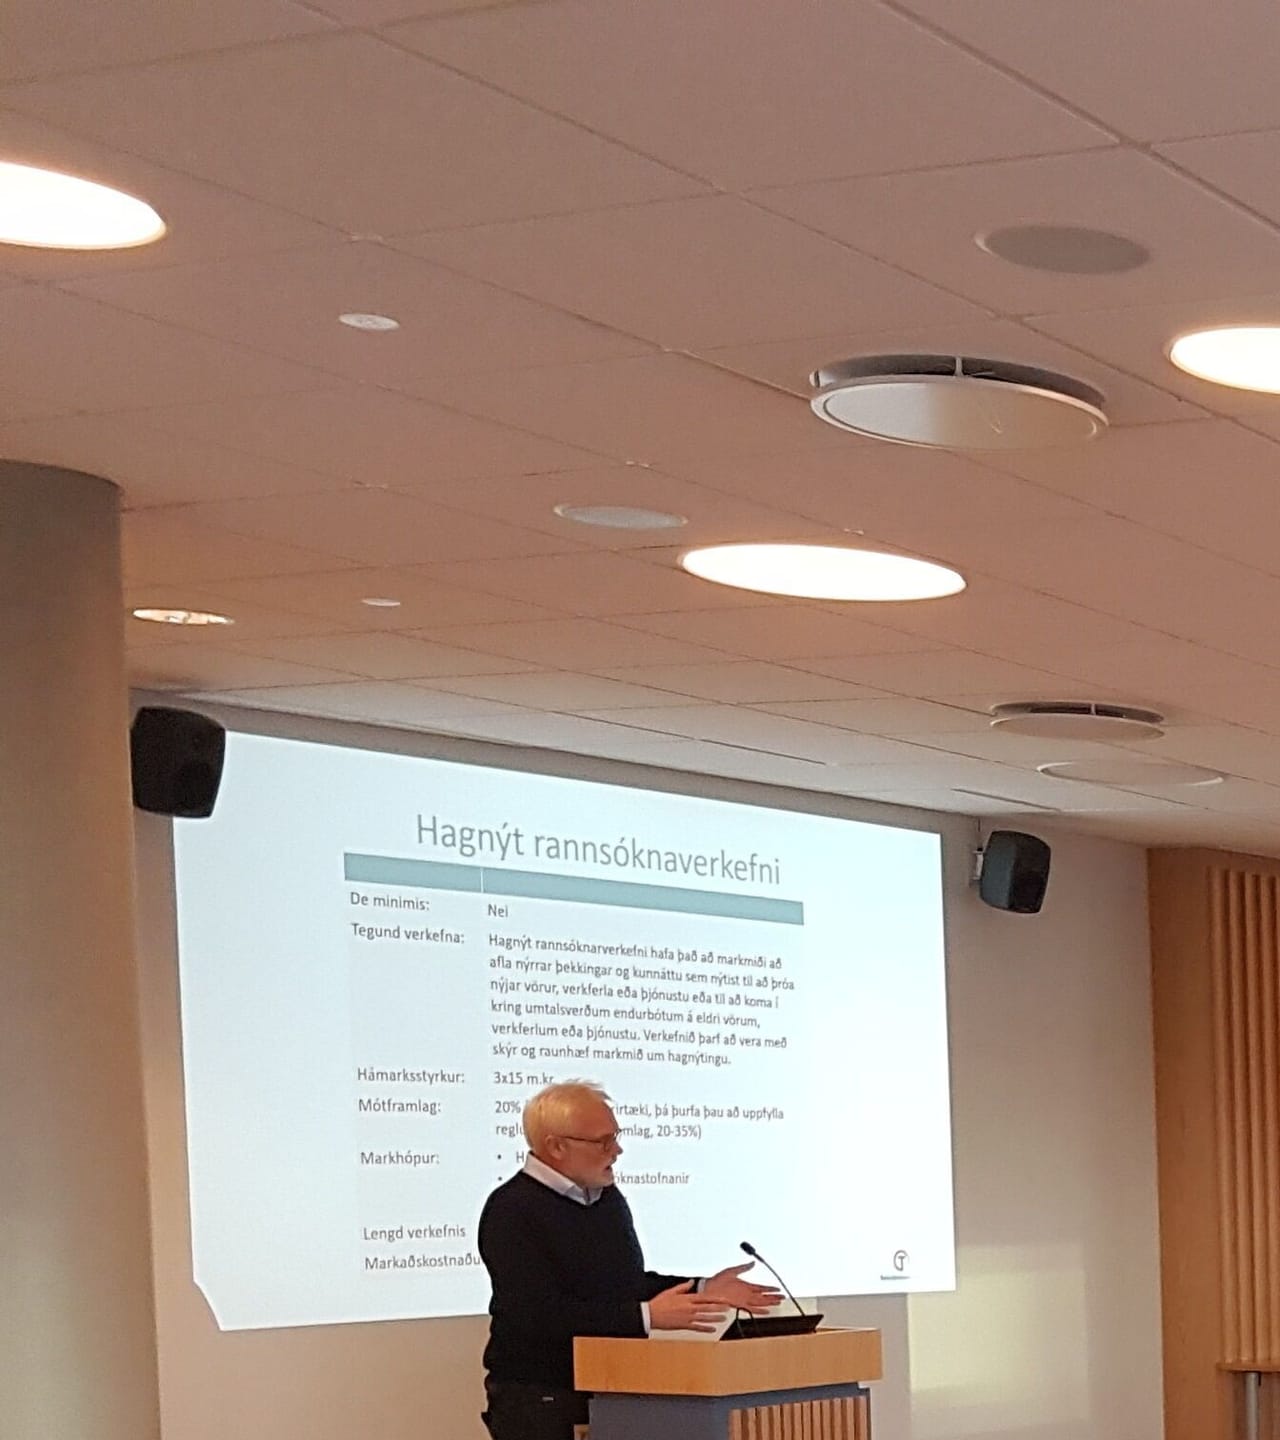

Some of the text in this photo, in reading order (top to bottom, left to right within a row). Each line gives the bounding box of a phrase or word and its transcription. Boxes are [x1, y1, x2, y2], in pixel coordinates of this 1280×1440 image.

[416, 813, 780, 884] Hagnýt rannsóknaverkefni
[349, 890, 430, 910] De minimis:
[486, 902, 509, 917] Nei
[350, 921, 465, 943] Tegund verkefna:
[487, 932, 782, 969] Hagnýt rannsóknarverkefni hafa það að markmiði að
[488, 953, 795, 991] afla nýrrar þekkingar og kunnáttu sem nýtist til að þróa
[489, 974, 522, 994] nýjar
[522, 979, 560, 995] vörur,
[561, 981, 614, 997] verkferla
[615, 984, 638, 998] eða
[639, 985, 690, 1002] þjónustu
[691, 989, 712, 1003] eða
[713, 991, 726, 1004] til
[727, 992, 742, 1005] að
[742, 993, 773, 1008] koma
[489, 998, 761, 1028] kring umtalsverðum endurbótum á eldri vörum,
[490, 1020, 788, 1048] verkferlum eða þjónustu. Verkefnið þarf að vera með
[491, 1040, 732, 1067] skýr og raunhæf markmið um hagnýtingu.
[356, 1065, 465, 1085] Hámarksstyrkur:
[492, 1070, 554, 1085] 3x15 m.kr
[357, 1096, 441, 1115] Mótframlag:
[494, 1099, 522, 1113] 20%
[653, 1102, 669, 1119] þá
[670, 1102, 701, 1119] þurfa
[702, 1104, 724, 1120] þau
[725, 1104, 740, 1118] að
[741, 1105, 784, 1120] uppfylla
[494, 1118, 524, 1137] regl
[655, 1123, 702, 1139] 20-35%)
[359, 1148, 440, 1167] Markhópur:
[362, 1222, 466, 1243] Lengd verkefnis
[364, 1252, 481, 1270] Markaðskostnaðu
